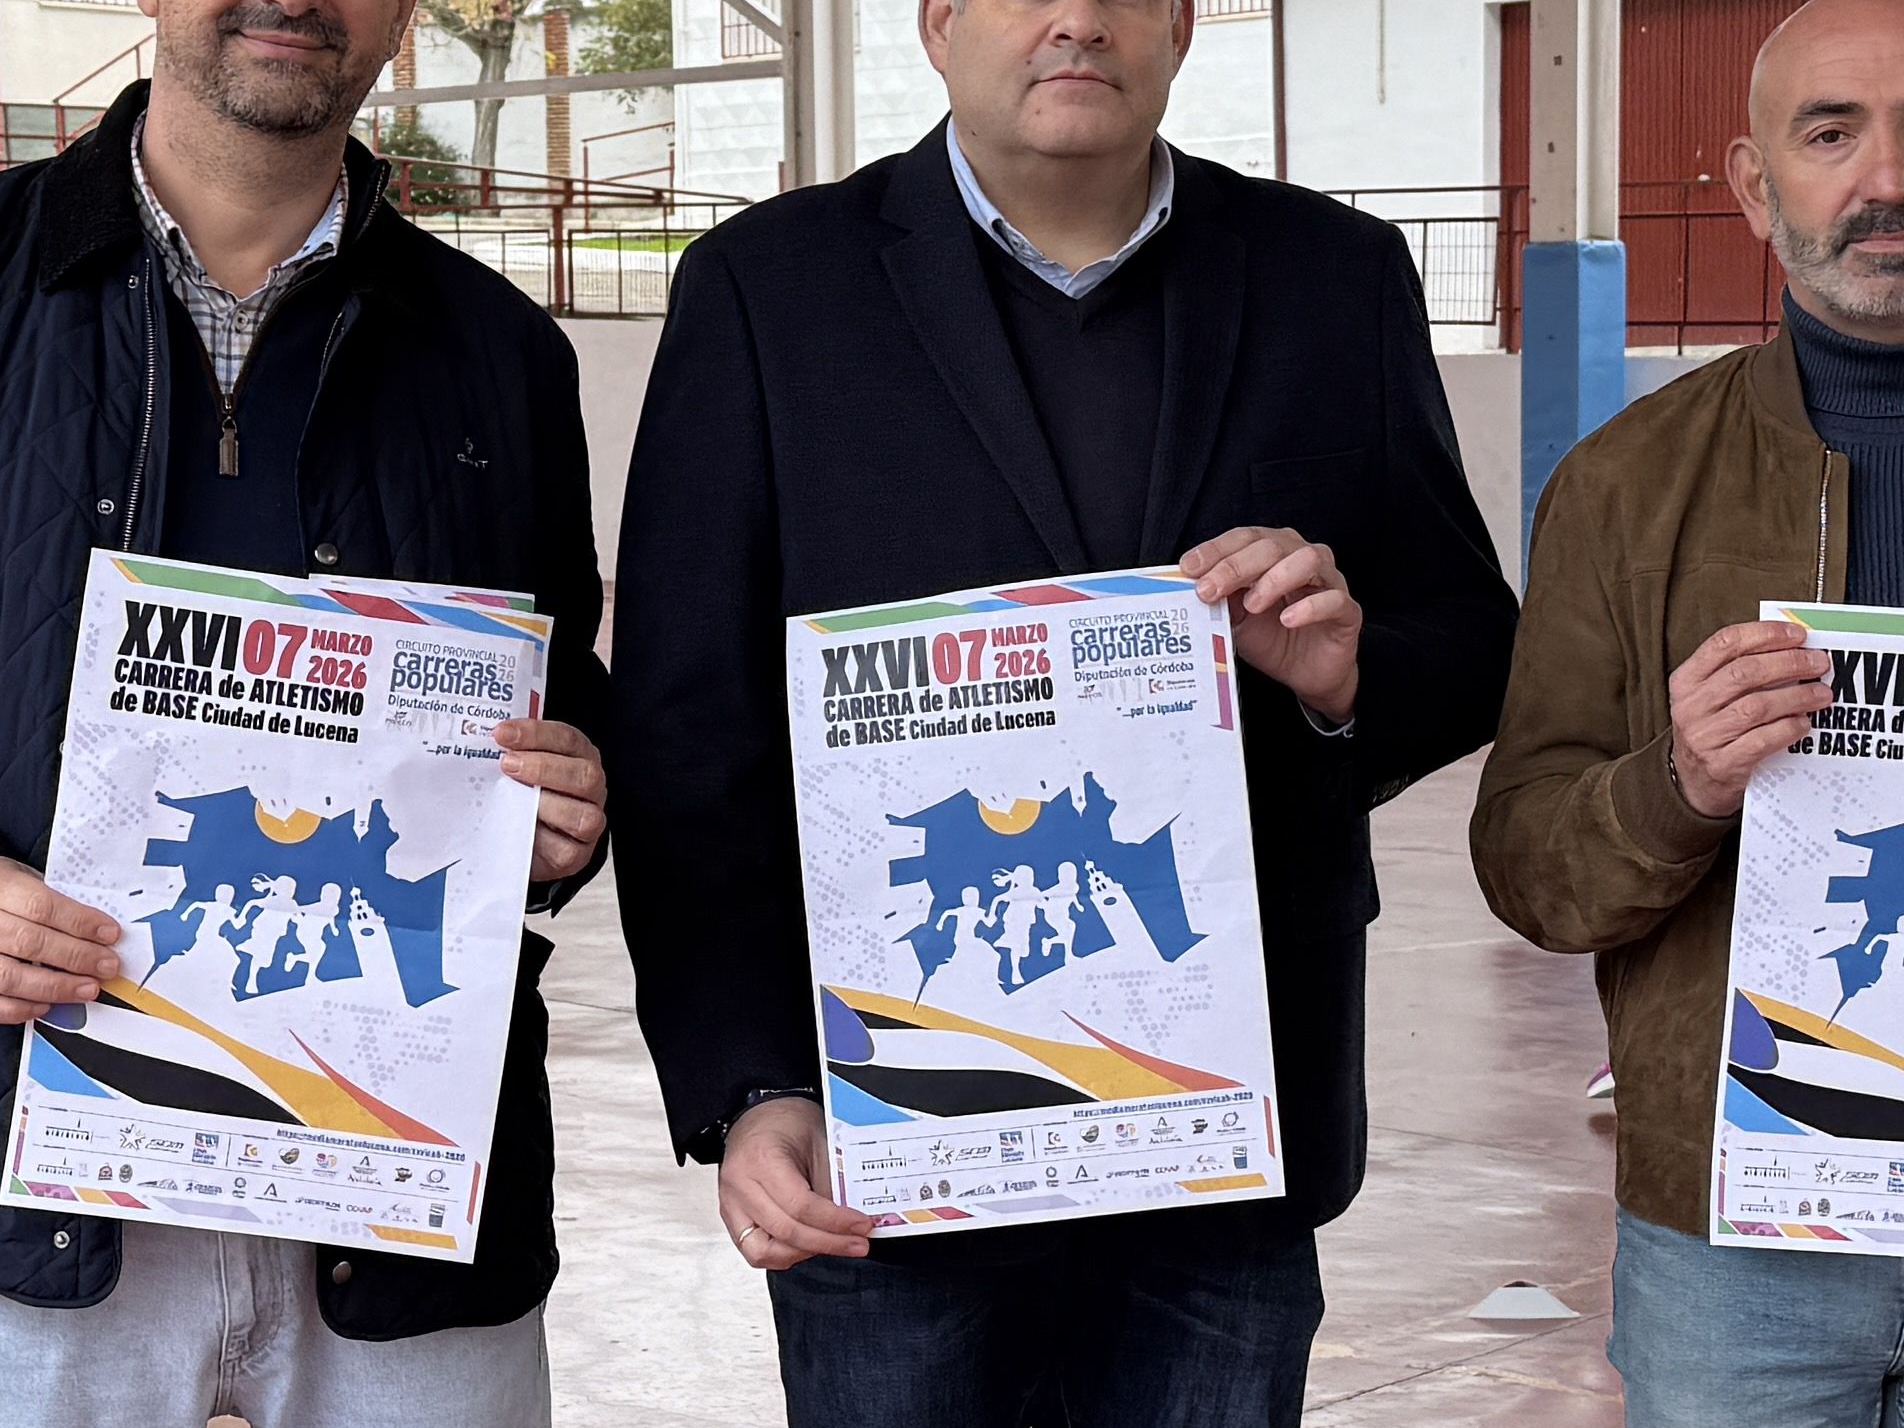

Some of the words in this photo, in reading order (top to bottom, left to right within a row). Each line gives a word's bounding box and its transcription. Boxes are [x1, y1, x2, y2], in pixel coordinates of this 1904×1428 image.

[1170, 608, 1188, 621] 20
[117, 600, 242, 671] XXVI
[243, 620, 308, 678] 07
[311, 629, 373, 656] MARZO
[991, 622, 1048, 648] MARZO
[1070, 620, 1171, 646] carreras
[393, 651, 497, 682] carreras
[396, 639, 441, 655] CIRCUITO
[443, 645, 497, 663] PROVINCIAL
[498, 655, 516, 669] 20
[821, 635, 930, 698] XXVI
[932, 629, 987, 685] 07
[994, 648, 1051, 679] 2026
[1072, 634, 1192, 670] populares
[114, 658, 212, 695] CARRERA
[219, 674, 245, 699] de
[250, 679, 364, 716] ATLETISMO
[307, 655, 367, 689] 2026
[389, 668, 513, 702] populares
[110, 686, 138, 712] de
[142, 690, 198, 720] BASE
[202, 702, 266, 730] Ciudad
[268, 712, 291, 734] de
[294, 715, 359, 744] Lucena
[388, 694, 448, 712] Diputación
[823, 691, 915, 723] CARRERA
[919, 689, 944, 713] de
[948, 676, 1054, 710] ATLETISMO
[826, 724, 851, 749] de
[854, 718, 907, 746] BASE
[909, 714, 968, 740] Ciudad
[972, 713, 992, 733] de
[995, 710, 1056, 731] Lucena
[1806, 705, 1886, 733] RRERA
[1818, 732, 1873, 758] BASE
